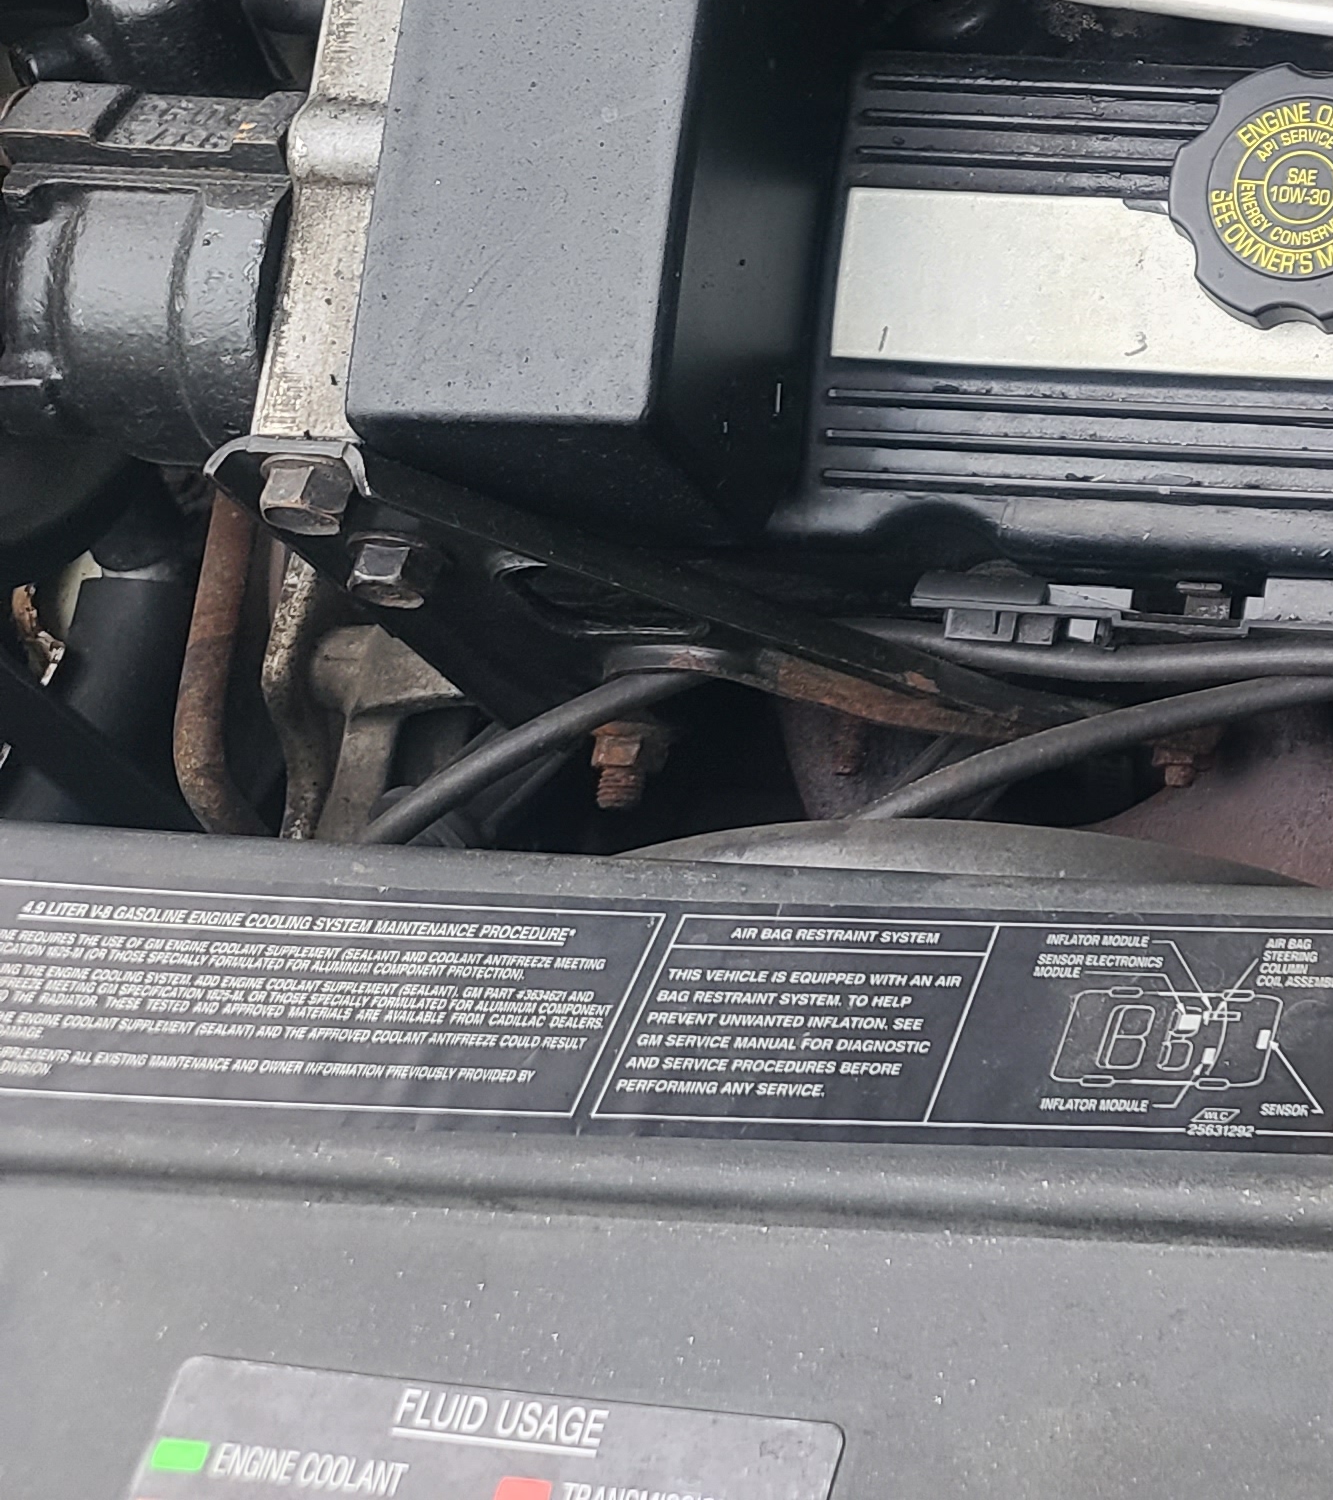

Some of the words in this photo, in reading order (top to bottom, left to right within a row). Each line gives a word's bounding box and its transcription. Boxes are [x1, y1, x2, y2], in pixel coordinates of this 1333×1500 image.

[1236, 102, 1310, 147] ENGINE
[1254, 139, 1280, 162] API
[1287, 168, 1318, 186] SAE
[1270, 186, 1330, 206] 10W-30
[1240, 184, 1272, 233] ENERGY
[1211, 190, 1236, 228] SEE
[1224, 223, 1313, 274] OWNER'S
[22, 901, 46, 914] 4.9
[46, 903, 89, 917] LITER
[90, 905, 113, 918] V-8
[113, 906, 188, 924] GASOLINE
[188, 910, 245, 927] ENGINE
[245, 914, 313, 930] COOLING
[313, 918, 373, 932] SYSTEM
[373, 919, 479, 938] MAINTENANCE
[730, 928, 758, 940] AIR
[760, 928, 793, 941] BAG
[796, 929, 879, 942] RESTRAINT
[879, 931, 941, 944] SYSTEM
[1046, 934, 1100, 946] INFLATOR
[1101, 935, 1149, 947] MODULE
[1265, 938, 1286, 949] AIR
[1287, 938, 1312, 950] BAG
[18, 930, 76, 945] REQUIRES
[77, 934, 101, 946] THE
[101, 935, 126, 948] USE
[126, 937, 144, 948] OF
[144, 938, 163, 950] GM
[165, 938, 210, 953] ENGINE
[209, 942, 266, 955] COOLANT
[265, 945, 342, 959] SUPPLEMENT
[402, 952, 426, 963] AND
[428, 952, 483, 965] COOLANT
[483, 954, 553, 968] ANTIFREEZE
[553, 957, 606, 970] MEETING
[1263, 951, 1318, 962] STEERING
[1037, 954, 1084, 965] SENSOR
[1085, 955, 1164, 968] ELECTRONICS
[1260, 963, 1309, 974] COLUMN
[668, 969, 702, 980] THIS
[705, 970, 769, 983] VEHICLE
[771, 971, 788, 983] IS
[790, 971, 866, 985] EQUIPPED
[869, 974, 908, 986] WITH
[909, 975, 933, 987] AN
[935, 976, 962, 987] AIR
[1033, 966, 1082, 978] MODULE
[1256, 976, 1284, 987] COIL
[656, 990, 690, 1002] BAG
[692, 991, 778, 1005] RESTRAINT
[848, 995, 868, 1006] TO
[871, 996, 912, 1008] HELP
[647, 1012, 717, 1026] PREVENT
[718, 1013, 805, 1028] UNWANTED
[892, 1019, 924, 1030] SEE
[637, 1034, 663, 1046] GM
[664, 1035, 731, 1048] SERVICE
[734, 1037, 797, 1050] MANUAL
[801, 1038, 833, 1050] FOR
[836, 1039, 931, 1053] DIAGNOSTIC
[625, 1057, 660, 1069] AND
[662, 1058, 729, 1071] SERVICE
[731, 1059, 836, 1074] PROCEDURES
[840, 1062, 902, 1075] BEFORE
[616, 1079, 718, 1094] PERFORMING
[720, 1082, 755, 1095] ANY
[1040, 1098, 1098, 1111] INFLATOR
[1099, 1099, 1150, 1112] MODULE
[1260, 1103, 1309, 1117] SENSOR
[1187, 1124, 1255, 1137] 25631292
[394, 1389, 491, 1429] FLUID
[500, 1401, 609, 1447] USAGE
[211, 1442, 300, 1481] ENGINE
[300, 1453, 409, 1496] COOLANT
